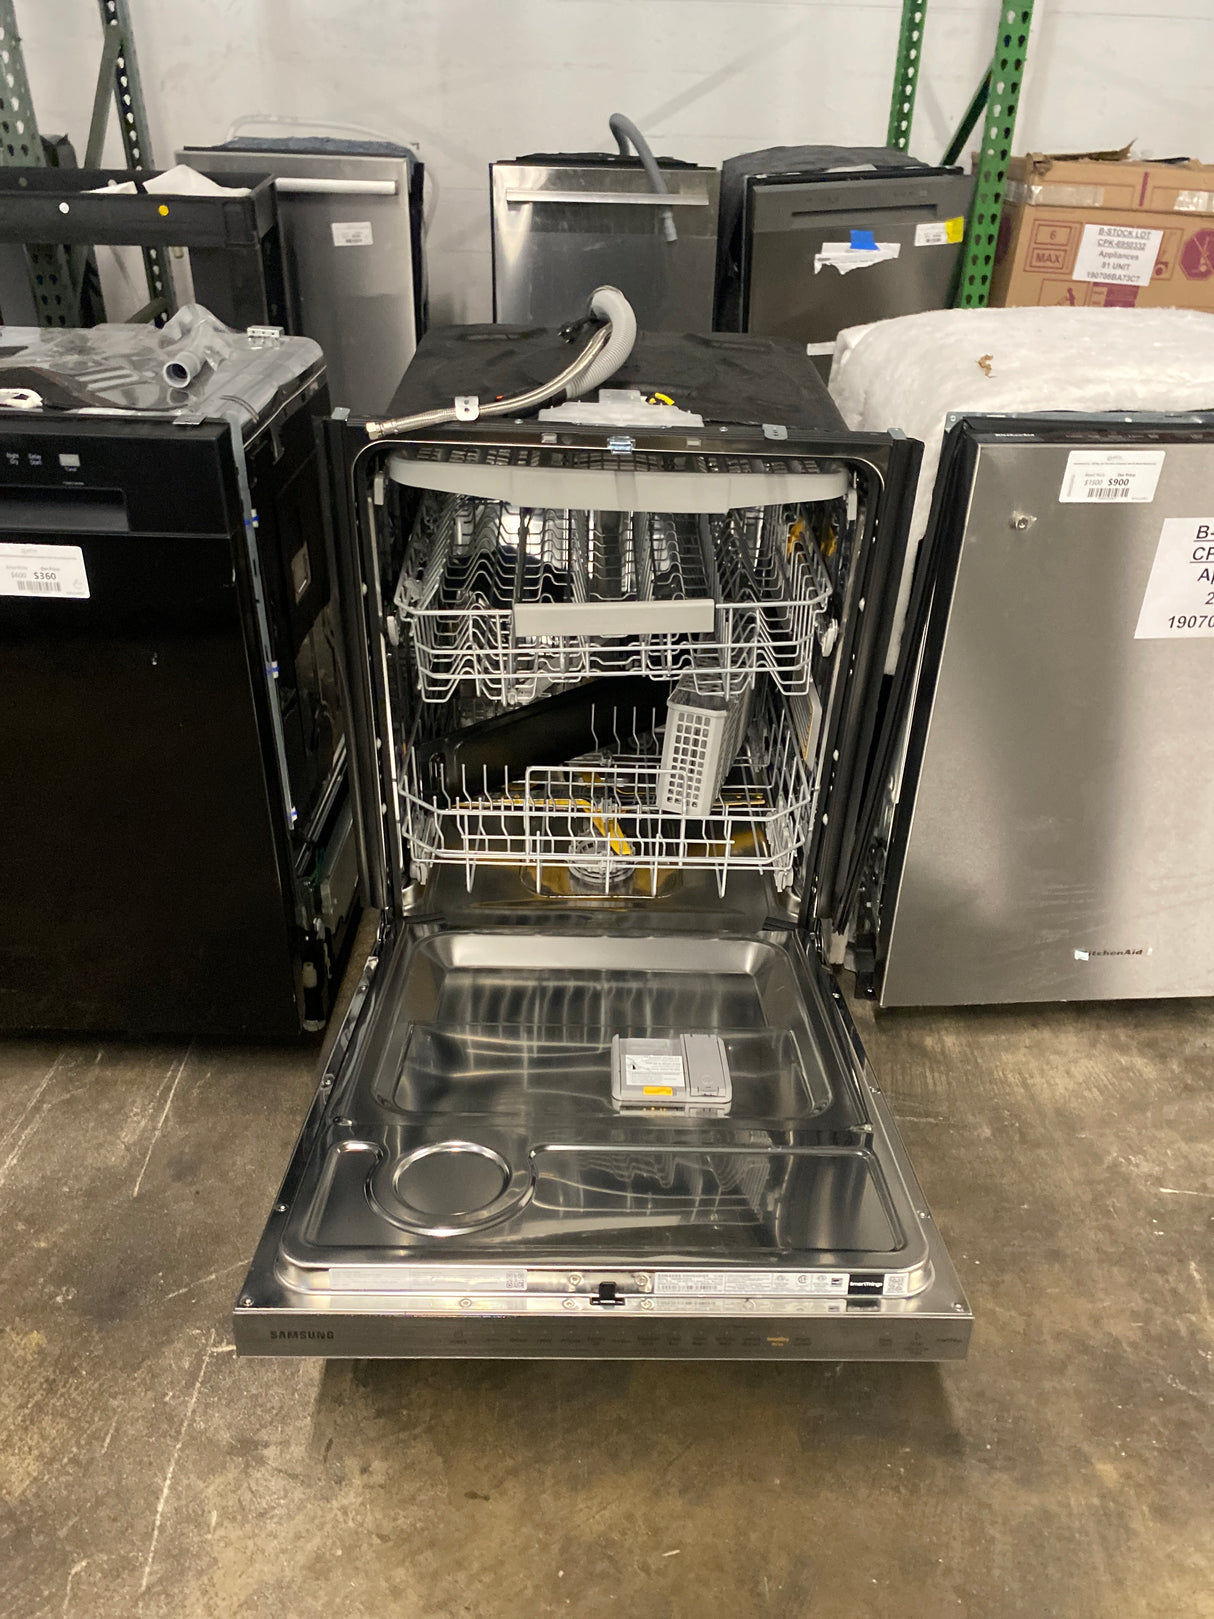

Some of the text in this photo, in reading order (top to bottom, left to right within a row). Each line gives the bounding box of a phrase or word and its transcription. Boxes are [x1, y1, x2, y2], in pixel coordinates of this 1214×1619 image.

[1050, 230, 1057, 240] 6
[1135, 231, 1152, 240] LOT
[1036, 253, 1061, 264] MAX
[1098, 250, 1139, 261] Appliances
[1112, 262, 1131, 270] UNIT
[1108, 478, 1129, 486] $900
[34, 572, 57, 580] $360
[1085, 949, 1143, 957] itchenAid
[270, 1330, 335, 1340] SAMSUNG
